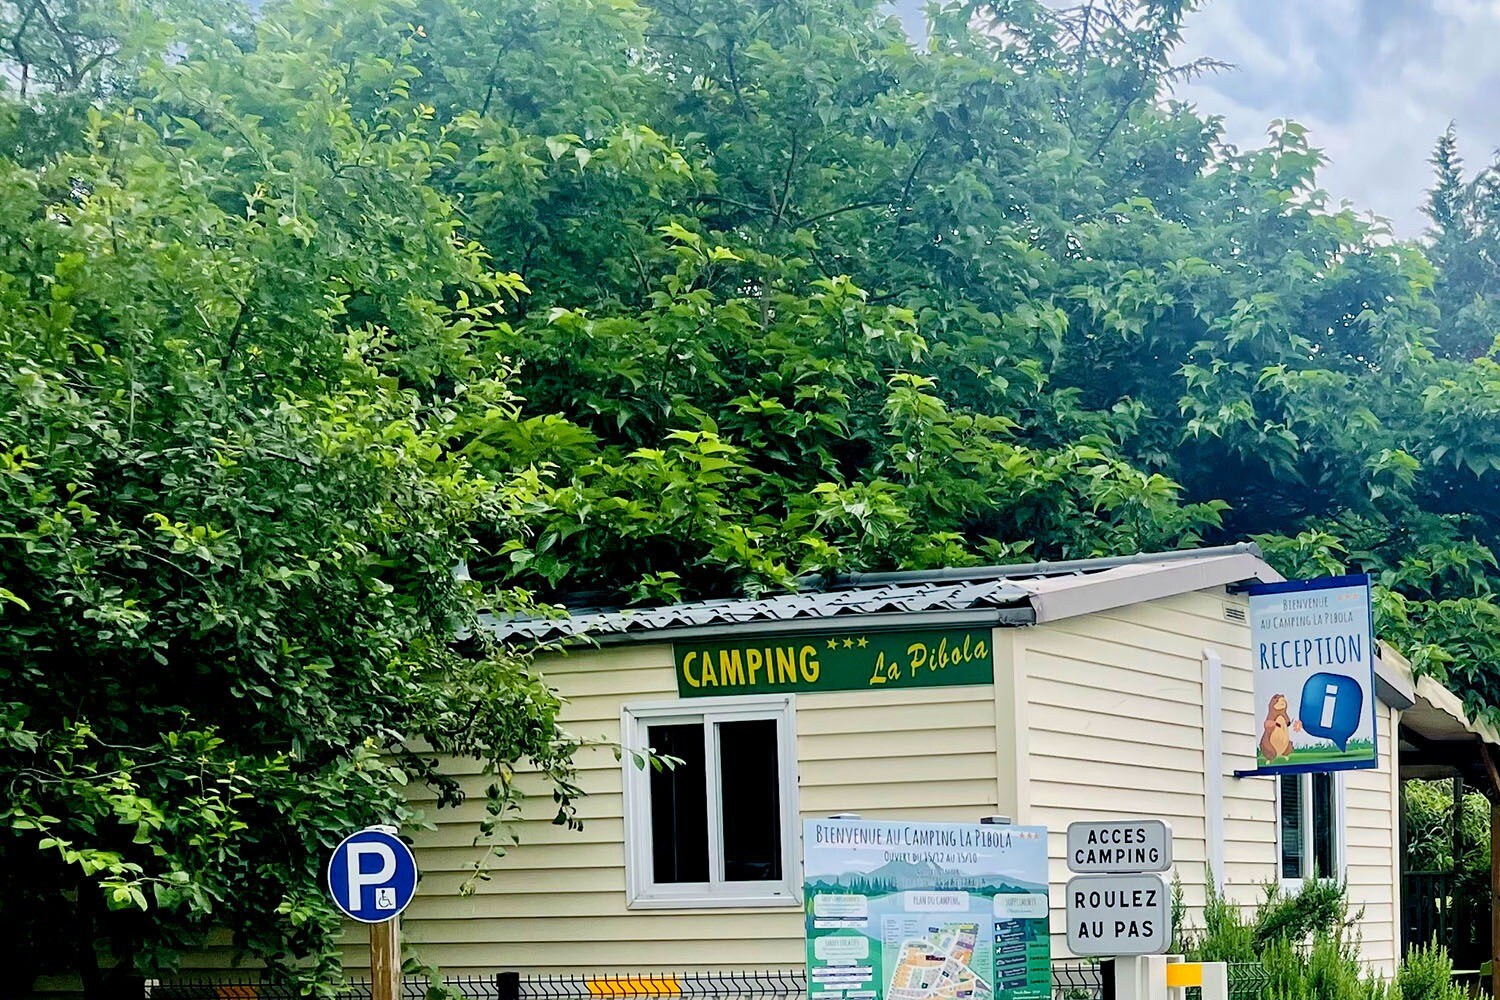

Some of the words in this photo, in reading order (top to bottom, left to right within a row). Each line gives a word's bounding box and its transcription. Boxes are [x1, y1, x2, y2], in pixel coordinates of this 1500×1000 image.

[1282, 596, 1329, 611] BIENVENUE
[1260, 617, 1271, 630] AU
[1273, 616, 1312, 630] CAMPING
[1313, 613, 1323, 626] LA
[1324, 611, 1354, 625] PIBOLA
[683, 645, 820, 688] CAMPING
[869, 651, 902, 685] La
[906, 633, 989, 678] Pibola
[1259, 633, 1362, 670] RECEPTION
[816, 824, 882, 845] BIENVENUE
[886, 828, 900, 846] AU
[904, 826, 956, 847] CAMPING
[960, 828, 972, 847] LA
[975, 829, 1012, 848] PIBOLA
[1087, 828, 1146, 845] ACCES
[884, 850, 910, 862] OUVERT
[912, 852, 922, 862] DU
[946, 852, 955, 863] AU
[1075, 848, 1159, 864] CAMPING
[346, 842, 396, 911] P
[1075, 890, 1157, 908] ROULEZ
[1078, 921, 1104, 938] AU
[1114, 920, 1153, 938] PAS
